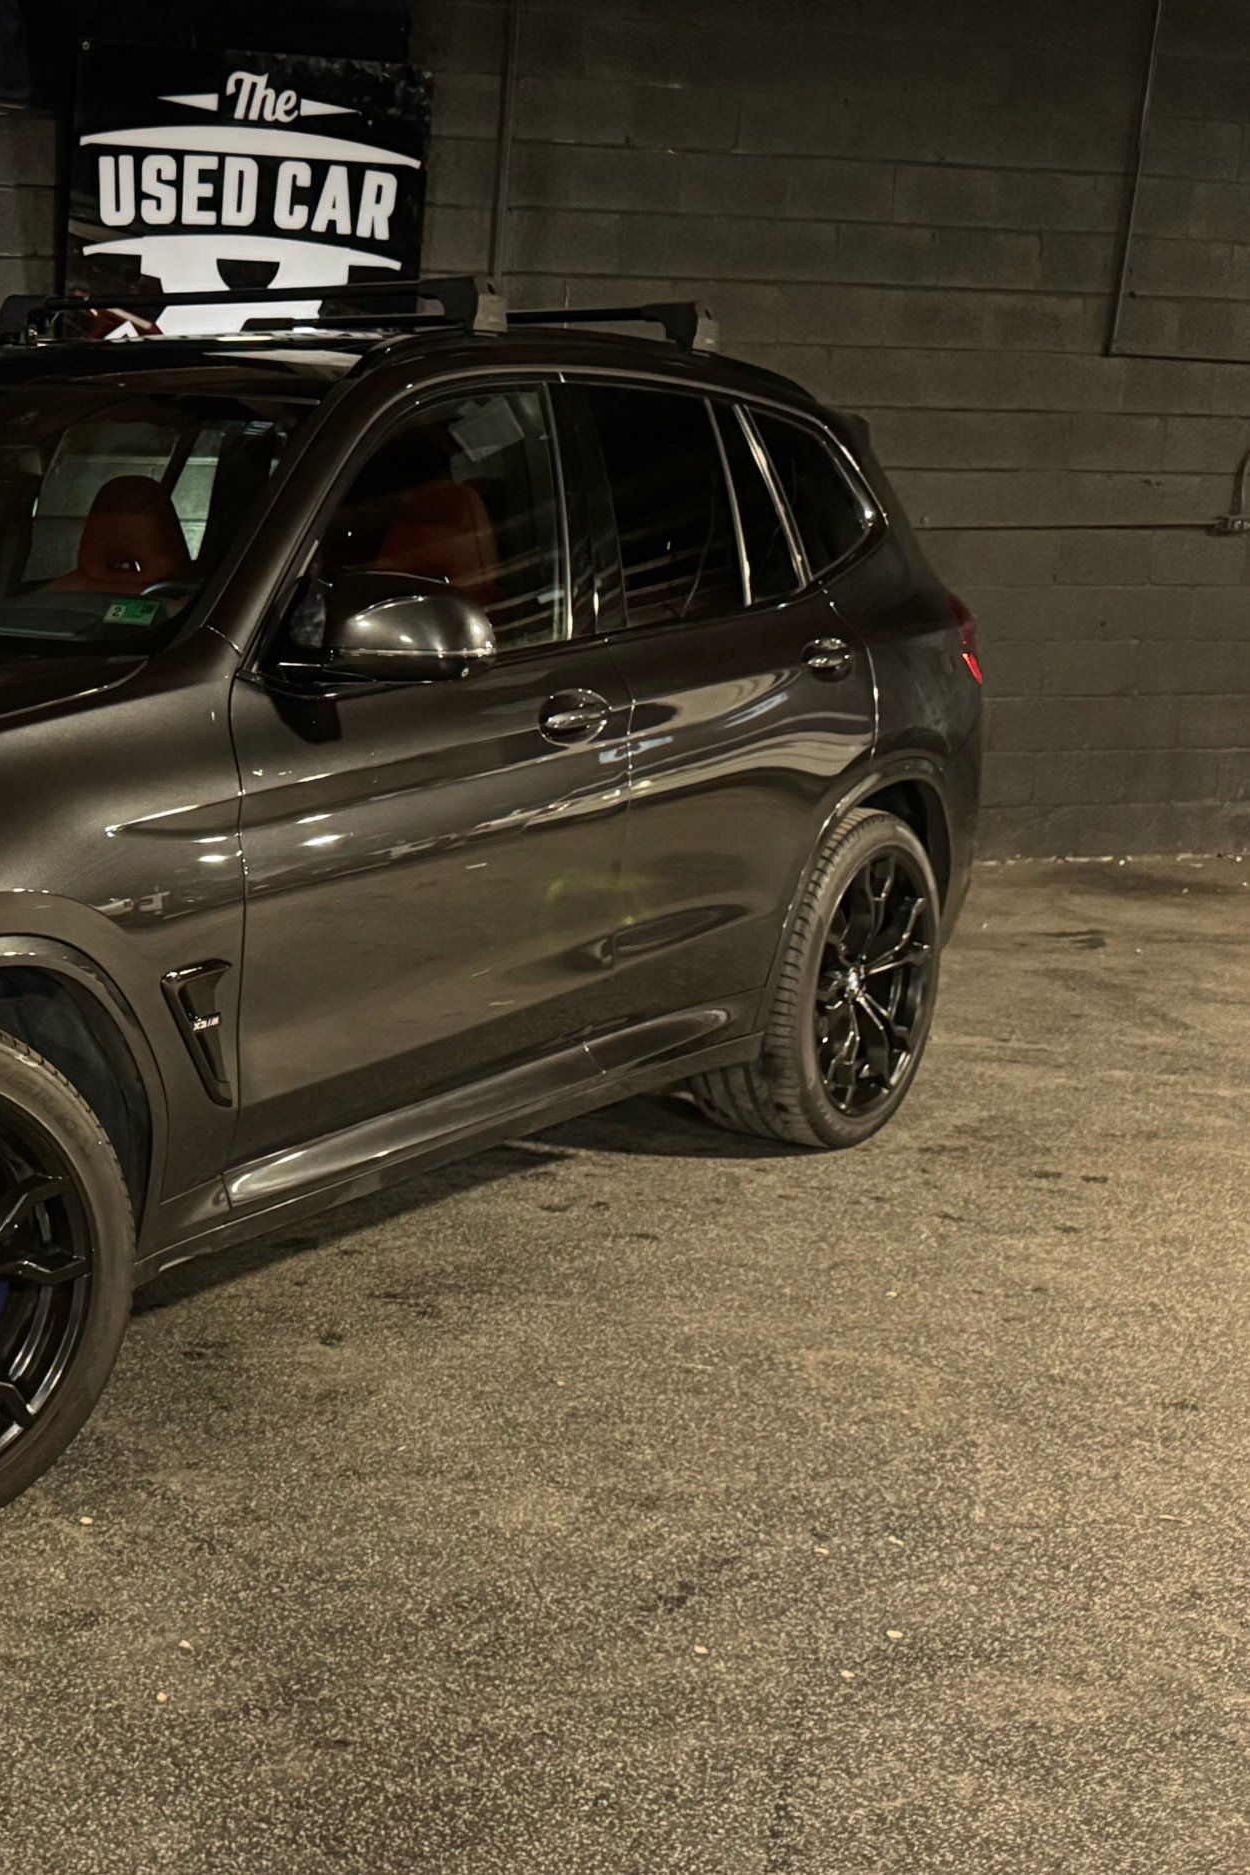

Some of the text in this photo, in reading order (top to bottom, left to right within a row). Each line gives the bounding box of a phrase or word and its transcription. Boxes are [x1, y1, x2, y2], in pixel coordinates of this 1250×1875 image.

[226, 71, 299, 123] The
[98, 154, 398, 240] USED CAR
